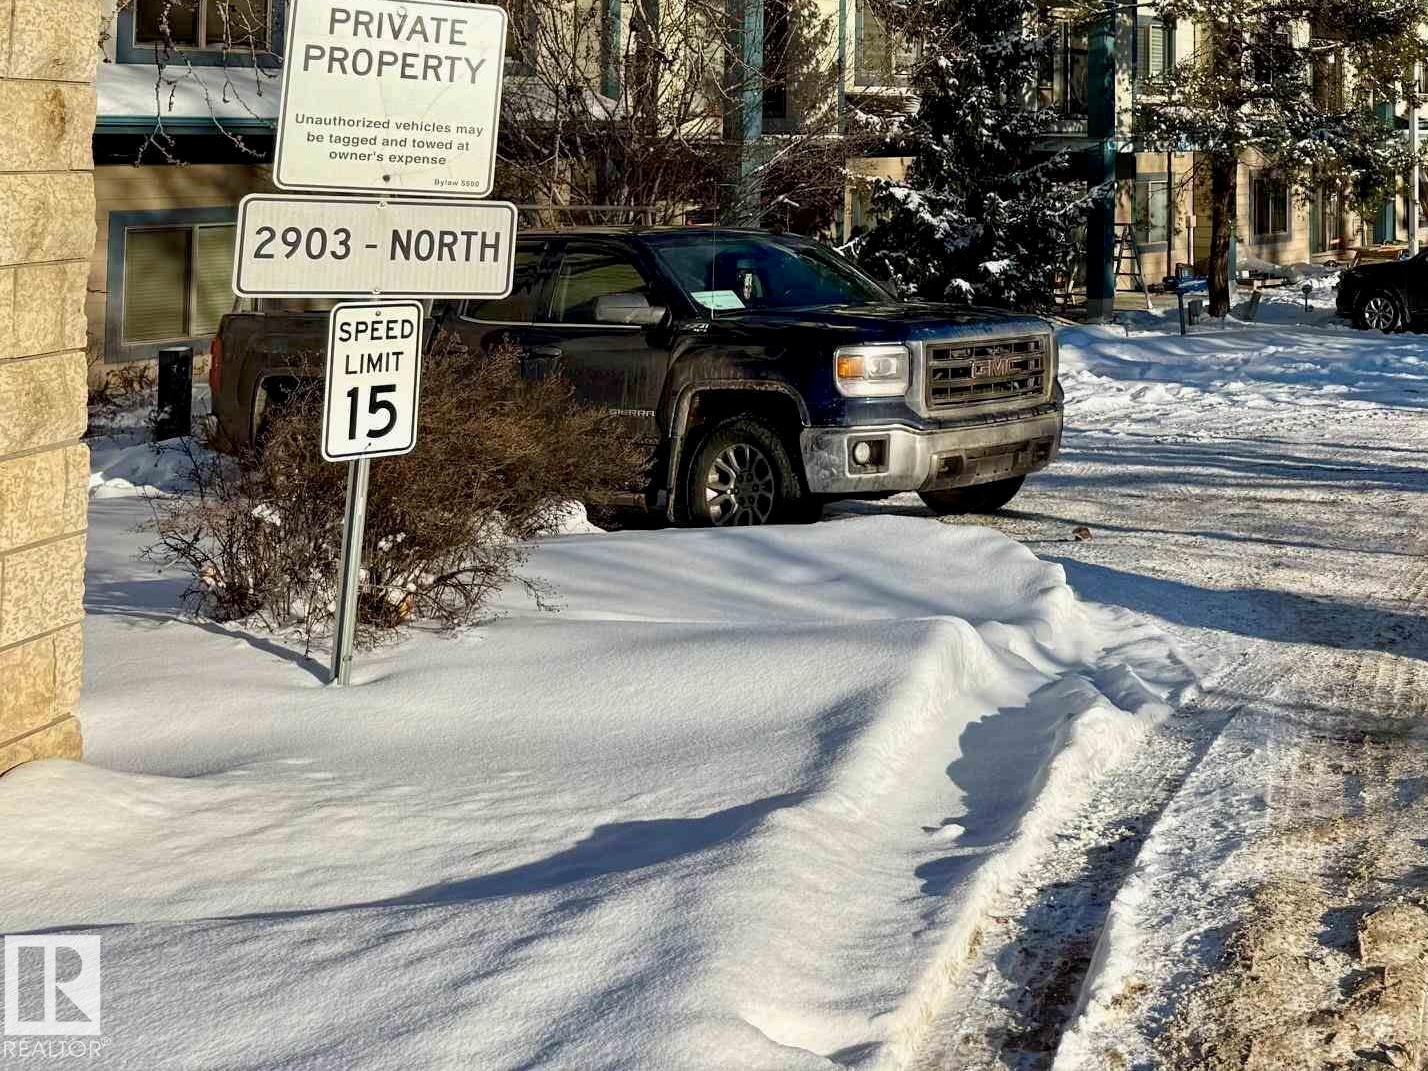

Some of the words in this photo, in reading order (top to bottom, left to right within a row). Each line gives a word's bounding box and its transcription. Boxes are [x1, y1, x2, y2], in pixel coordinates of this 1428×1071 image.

[329, 7, 468, 46] PRIVATE
[303, 44, 487, 84] PROPERTY
[295, 113, 390, 129] Unauthorized
[395, 121, 451, 133] vehicles
[456, 124, 484, 137] may
[307, 132, 324, 143] be
[329, 133, 377, 146] tagged
[381, 137, 408, 148] and
[412, 138, 453, 151] towed
[457, 141, 470, 151] at
[329, 150, 384, 162] owner's
[388, 153, 446, 165] expense
[252, 226, 352, 260] 2903
[390, 228, 500, 263] NORTH
[338, 319, 414, 343] SPEED
[344, 351, 404, 375] LIMIT
[970, 357, 1022, 379] GMC
[346, 384, 398, 441] 15
[608, 408, 656, 417] SIERRA
